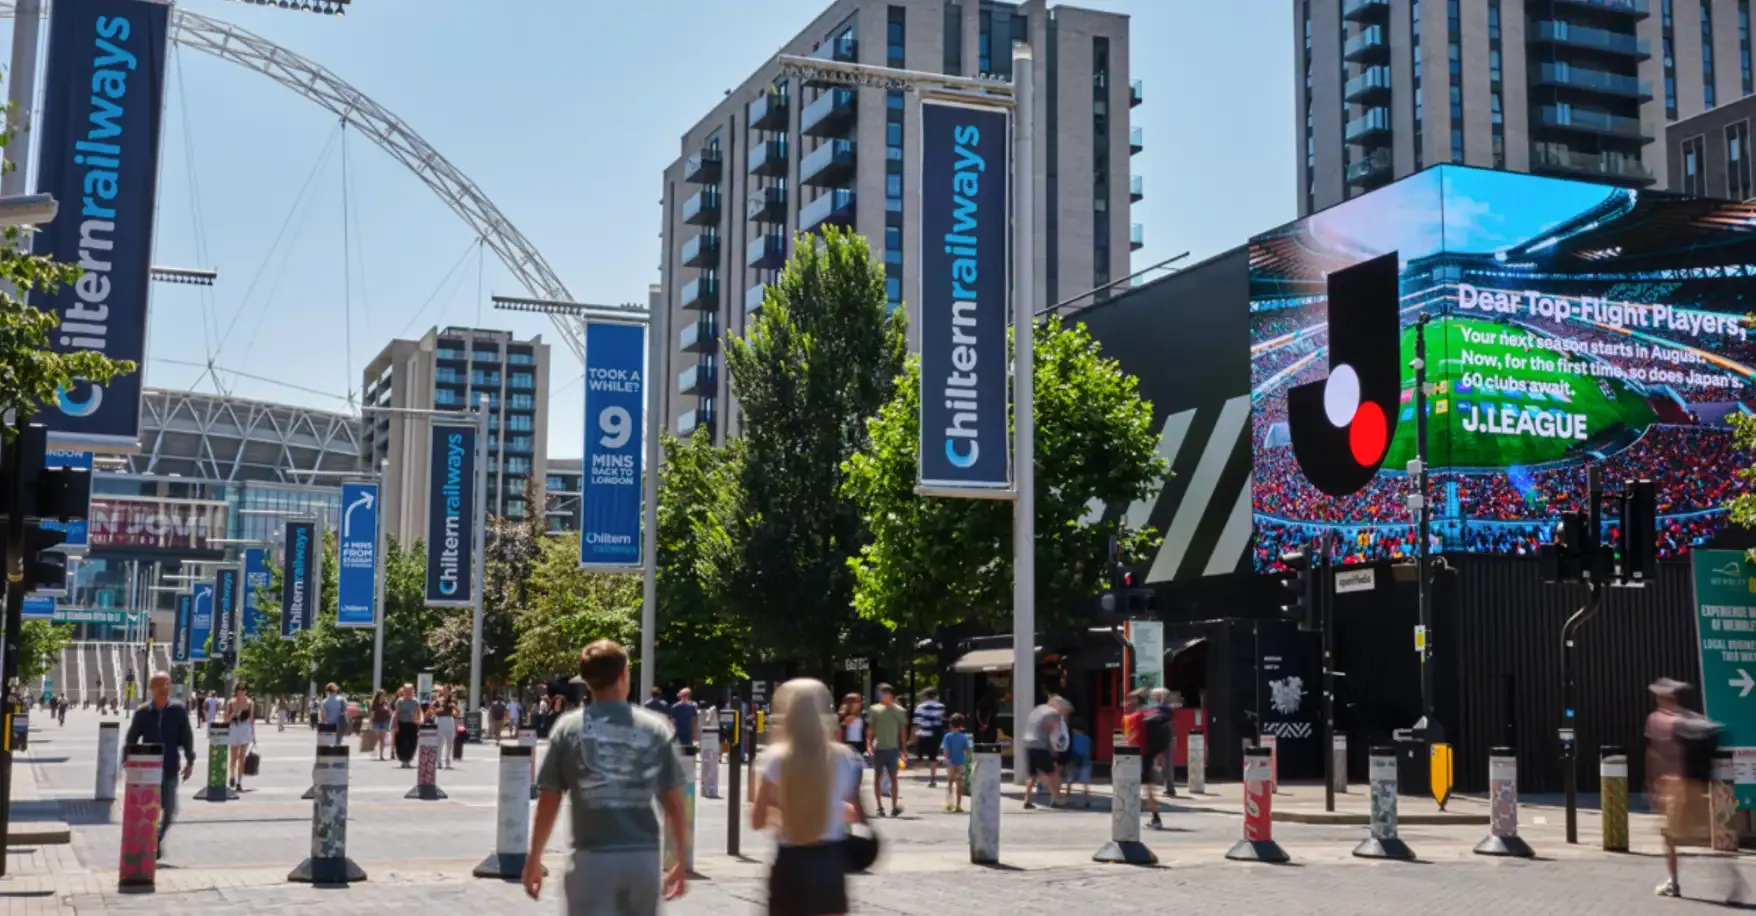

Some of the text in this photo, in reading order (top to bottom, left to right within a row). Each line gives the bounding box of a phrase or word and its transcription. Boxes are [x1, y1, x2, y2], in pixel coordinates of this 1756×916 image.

[56, 15, 137, 418] Cilternrailways
[944, 123, 985, 469] Chilternrailways
[1458, 283, 1747, 342] Dear Top-Flight Players,
[1461, 327, 1707, 365] Your next season starts in August.
[588, 368, 641, 381] TOOK A
[1461, 349, 1745, 390] Now, for the first time, so does Japan's.
[589, 380, 641, 393] WHILE?
[1462, 372, 1577, 397] 60 clubs await.
[598, 405, 633, 449] 9
[1462, 406, 1588, 440] J.LEAGUE
[591, 467, 634, 477] BACK TO
[592, 454, 634, 468] MINS
[591, 476, 634, 485] LONDON
[439, 433, 465, 595] Chilternrailways
[585, 532, 632, 545] Chiltern
[1702, 638, 1727, 650] LOCAL
